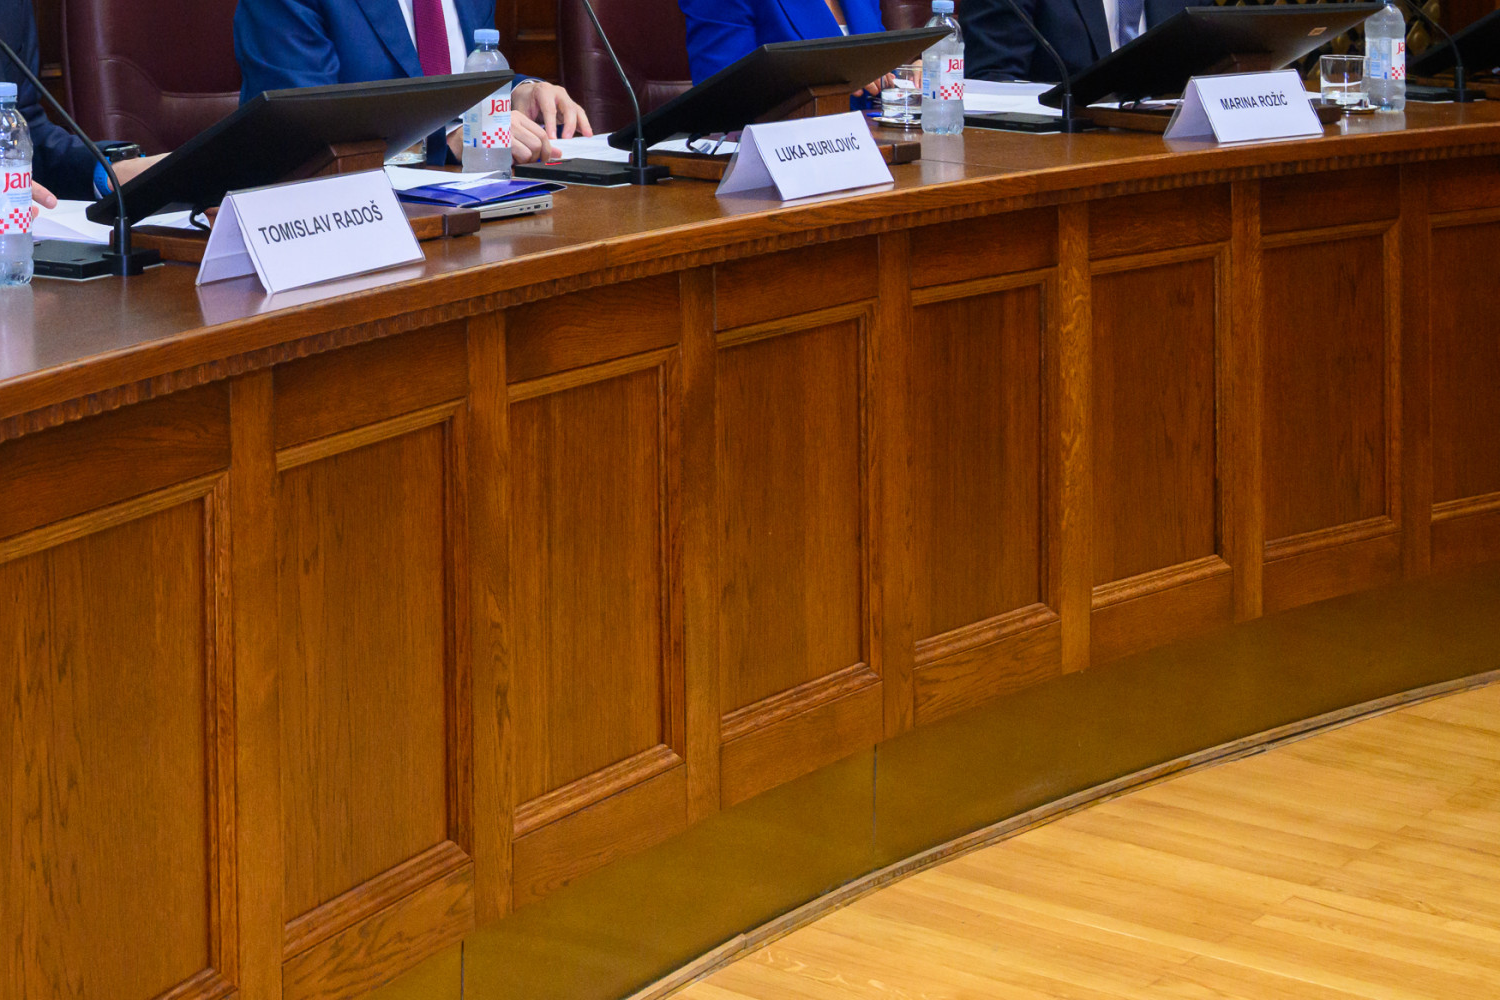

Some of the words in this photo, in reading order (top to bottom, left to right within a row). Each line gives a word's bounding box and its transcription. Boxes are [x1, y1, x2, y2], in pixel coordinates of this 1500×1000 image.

[1220, 96, 1260, 110] MARINA
[1258, 91, 1288, 108] ROŽIĆ
[775, 144, 809, 162] LUKA
[806, 132, 860, 156] BURILOVIĆ
[3, 171, 32, 193] Jan
[258, 214, 332, 244] TOMISLAV
[332, 200, 383, 229] RADOŠ
